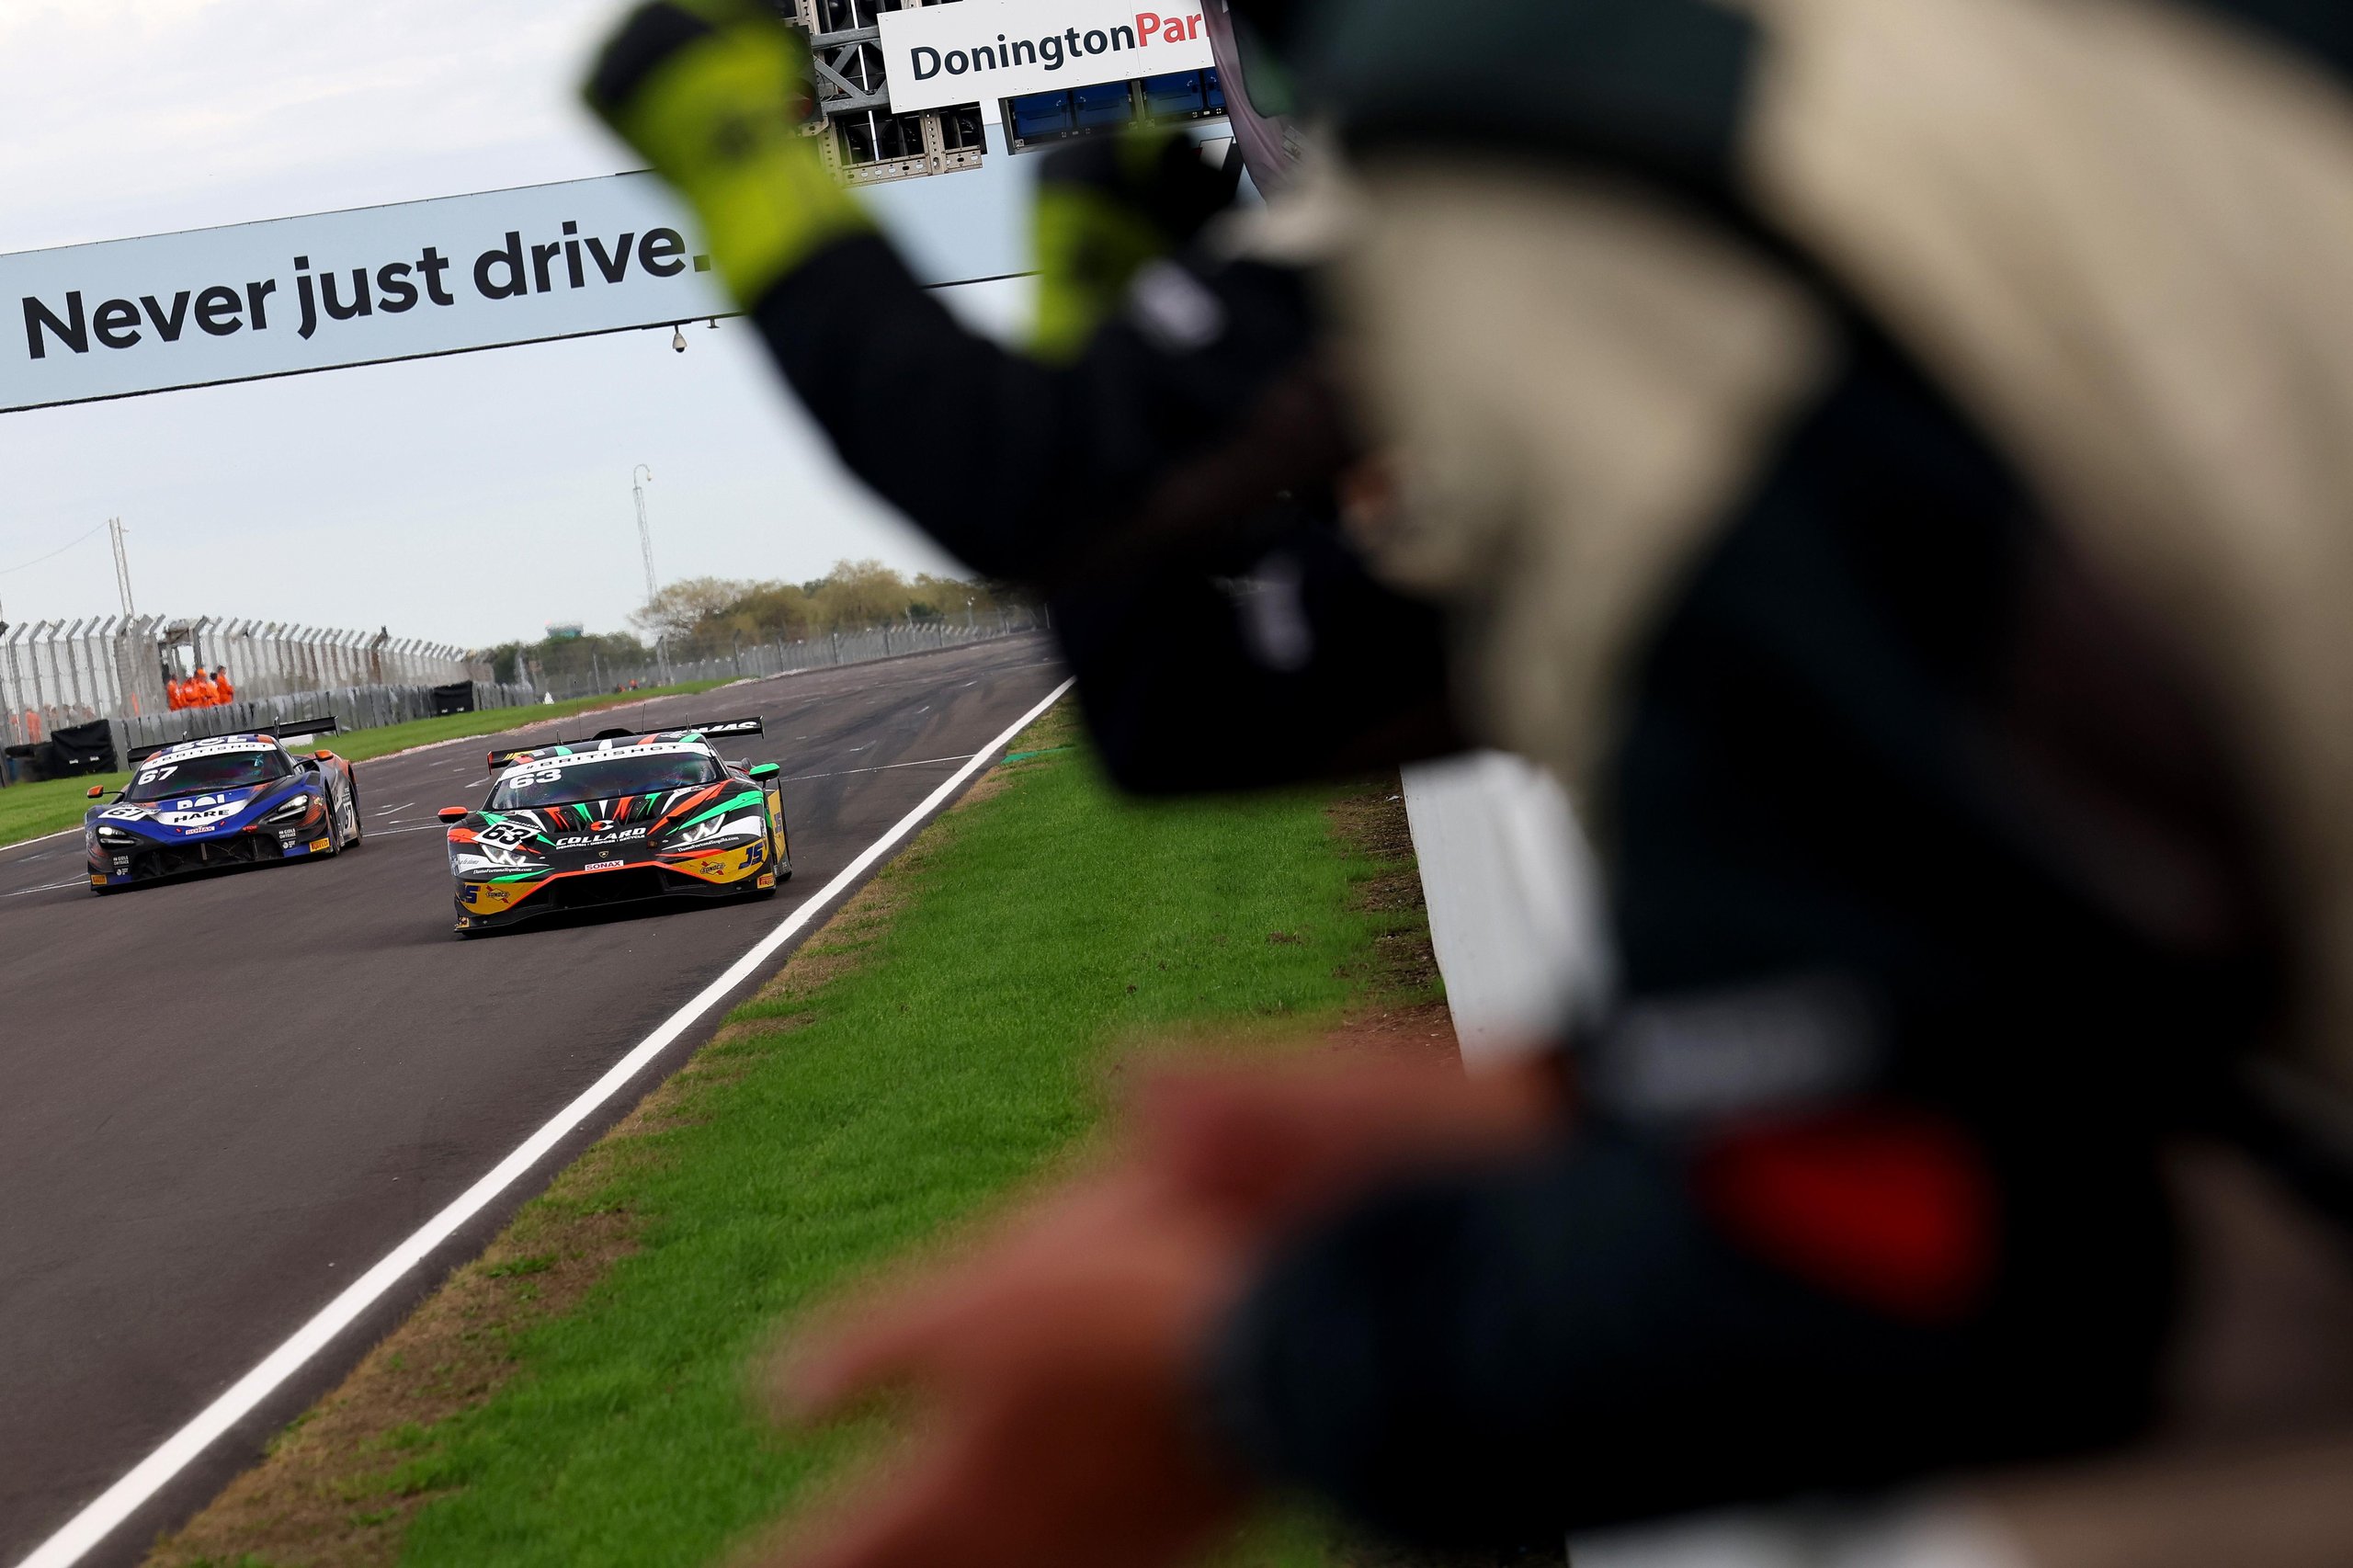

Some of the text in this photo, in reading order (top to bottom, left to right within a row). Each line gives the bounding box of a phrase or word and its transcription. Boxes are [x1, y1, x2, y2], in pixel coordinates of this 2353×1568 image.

[21, 220, 712, 360] Never just drive.
[138, 766, 178, 786] 67
[508, 767, 563, 790] 63
[108, 808, 144, 818] 67
[174, 809, 230, 824] HARE
[482, 824, 531, 845] 63
[555, 827, 647, 846] COLLARD
[619, 834, 645, 842] RECYCLE
[738, 842, 764, 869] JS
[585, 861, 620, 870] SONAX
[701, 864, 724, 873] SUNOCO
